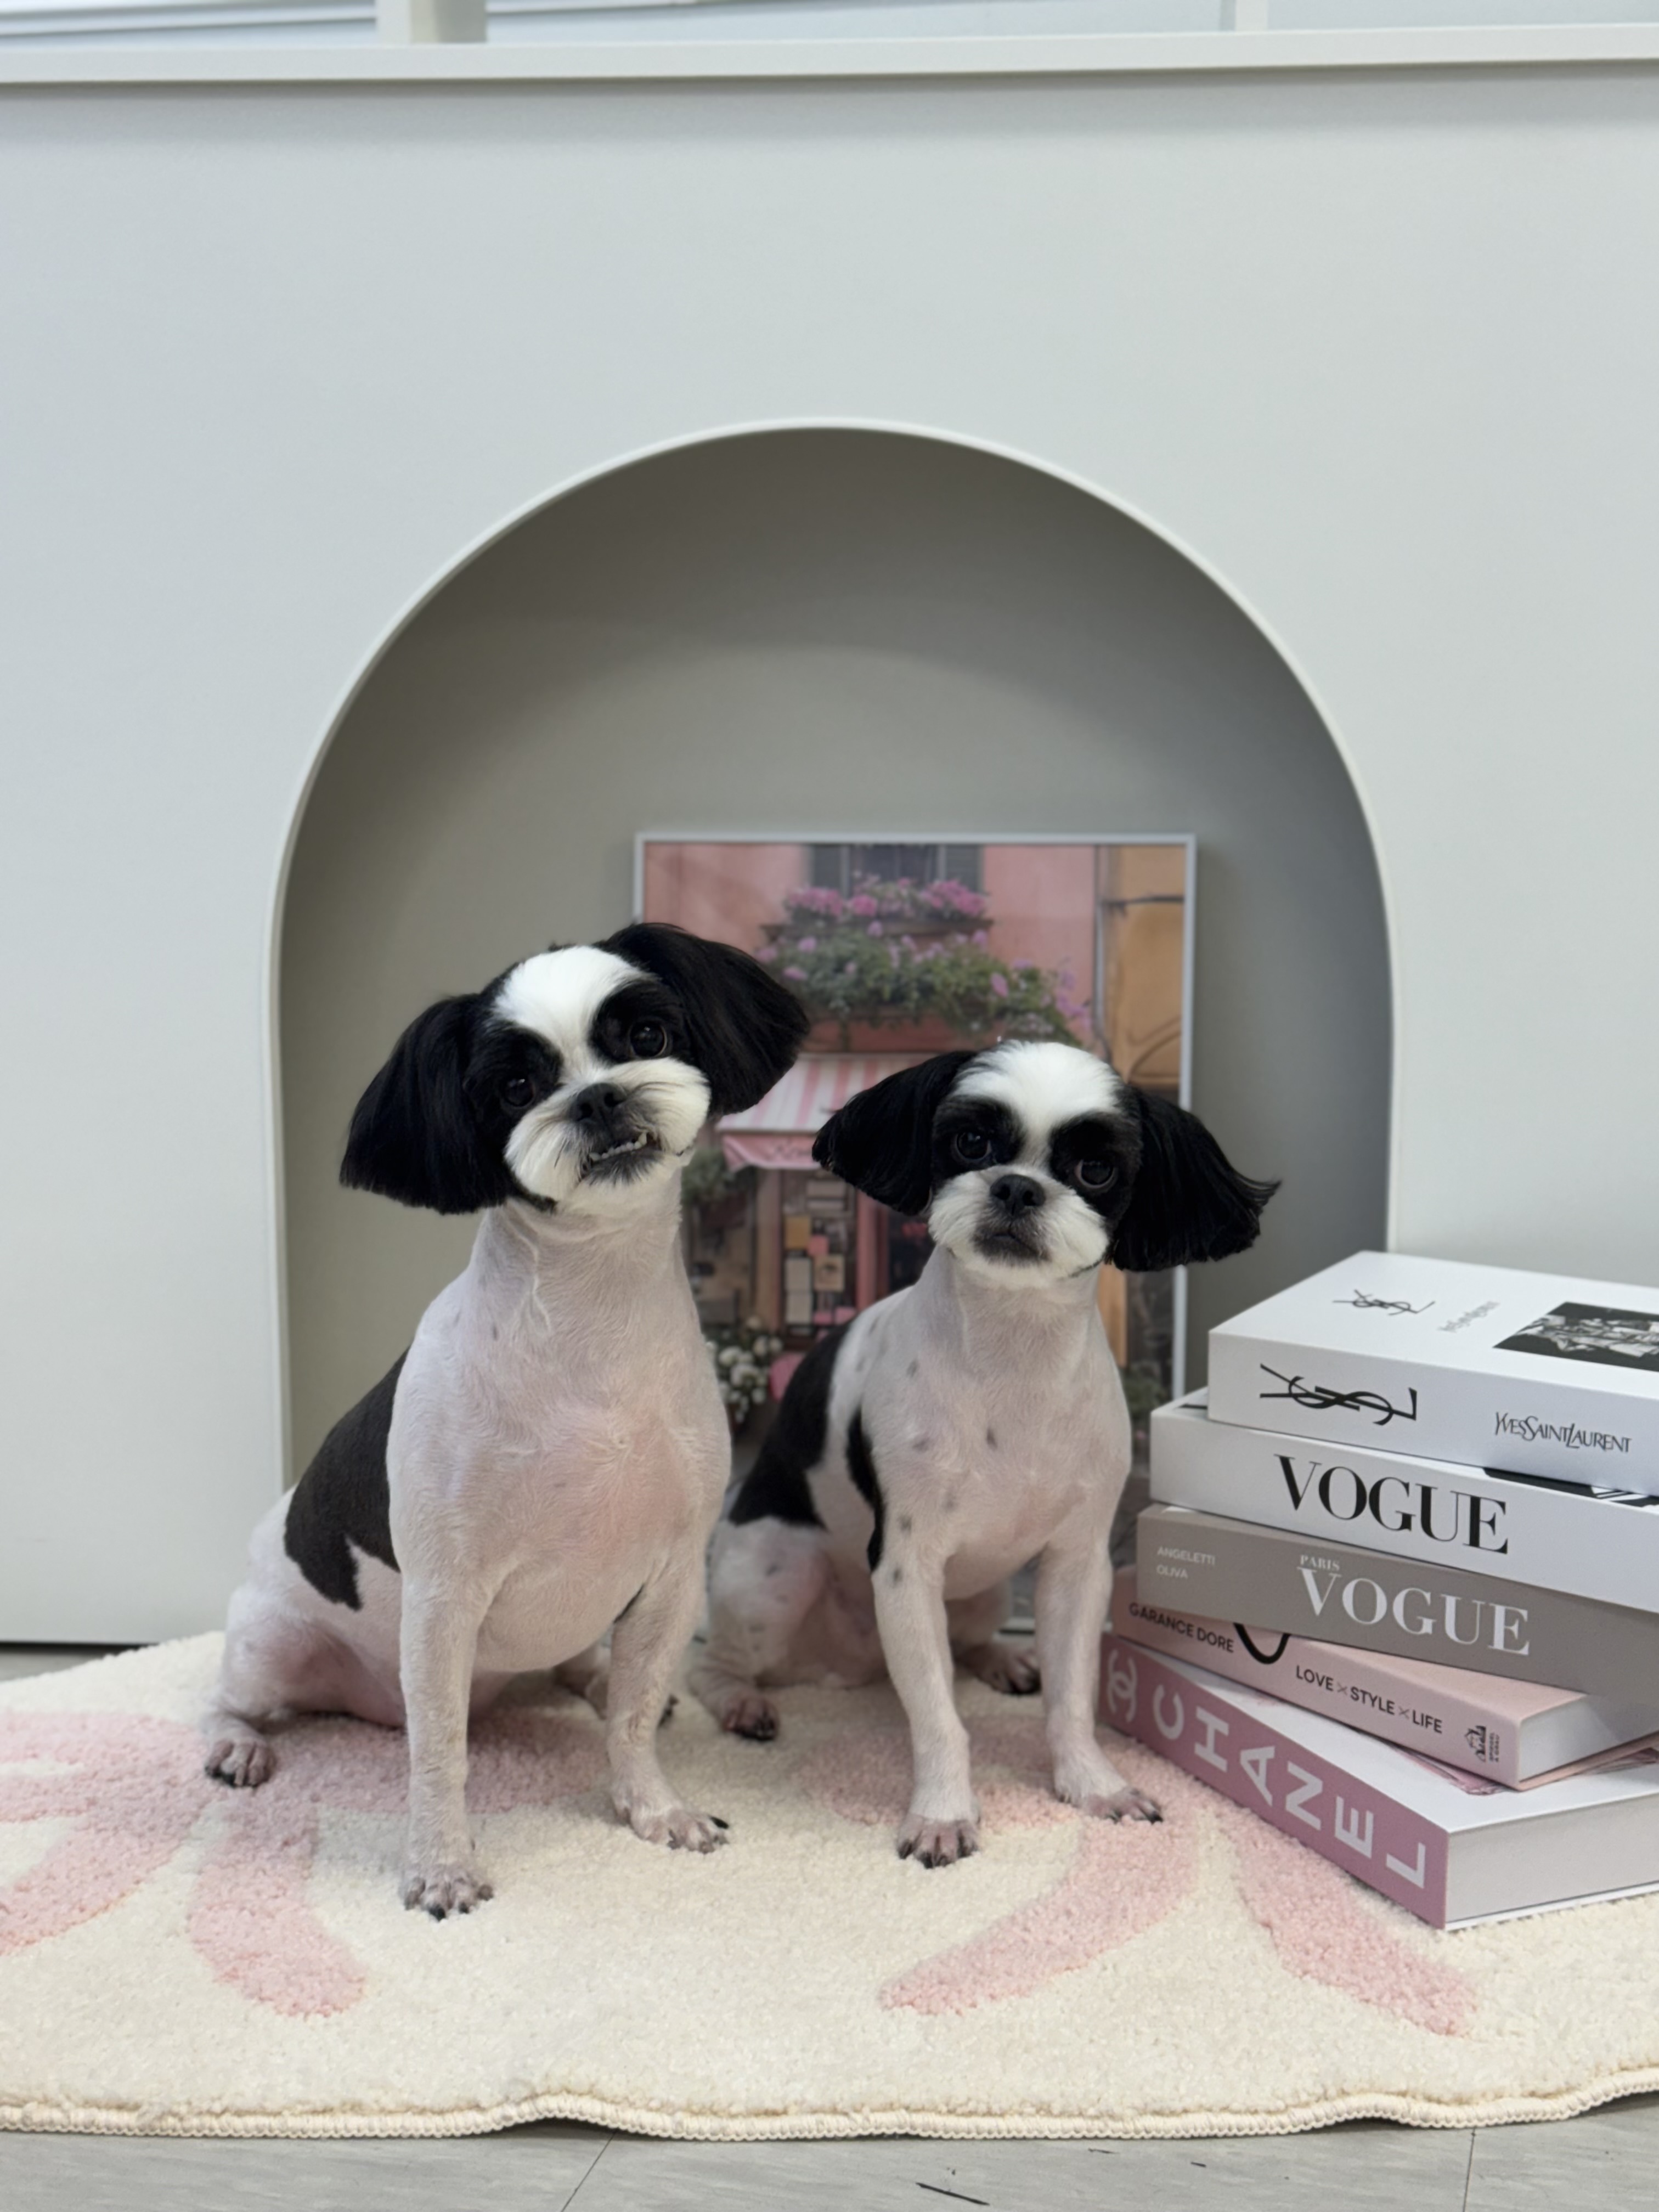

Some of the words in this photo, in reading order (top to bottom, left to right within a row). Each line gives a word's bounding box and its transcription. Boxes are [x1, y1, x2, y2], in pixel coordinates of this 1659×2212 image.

[1273, 1453, 1508, 1555] VOGUE
[1156, 1546, 1216, 1566] ANGELETTI
[1156, 1564, 1189, 1579] OLIVA
[1300, 1554, 1341, 1572] PARIS
[1129, 1602, 1194, 1639] GARANCE
[1197, 1627, 1234, 1654] DORE
[1296, 1566, 1530, 1656] VOGUE
[1296, 1664, 1334, 1691] LOVE
[1350, 1686, 1395, 1716] STYLE
[1412, 1709, 1443, 1734] LIFE
[1153, 1684, 1426, 1890] CHANEL
